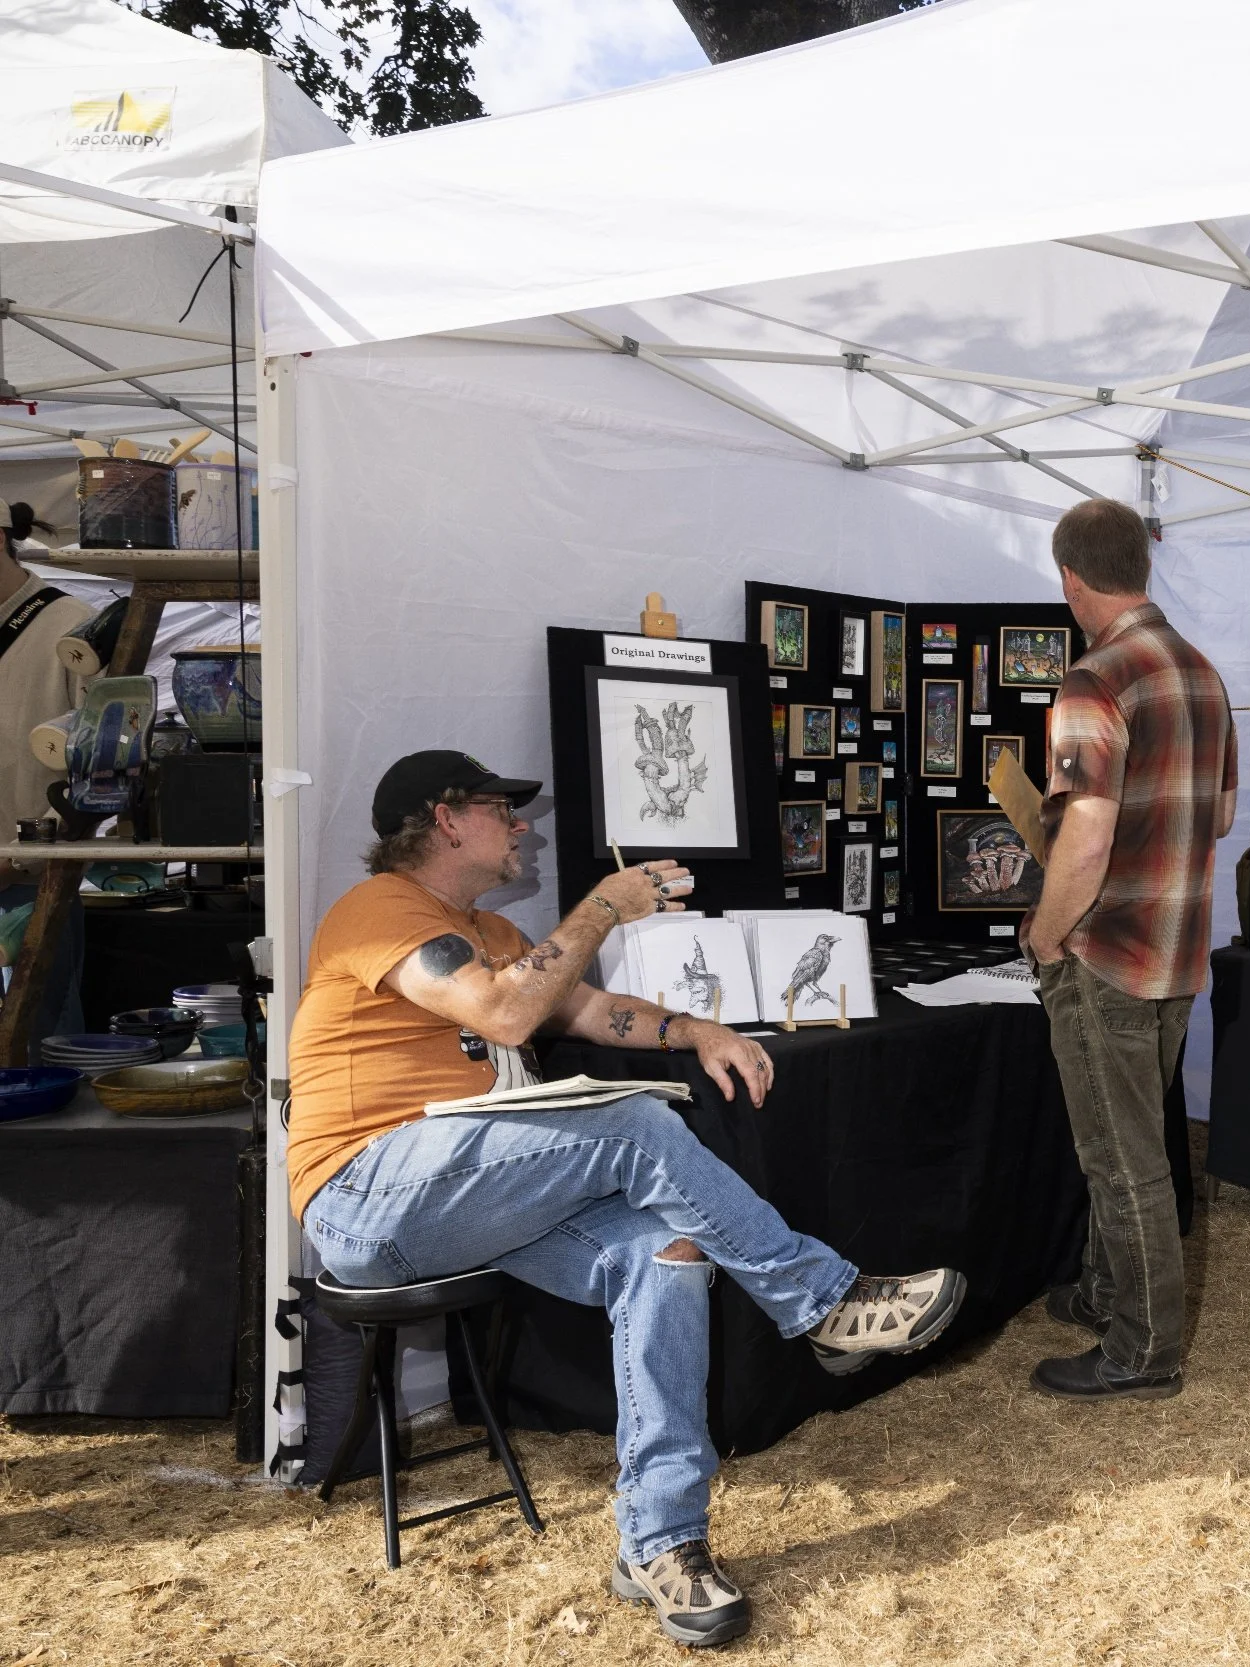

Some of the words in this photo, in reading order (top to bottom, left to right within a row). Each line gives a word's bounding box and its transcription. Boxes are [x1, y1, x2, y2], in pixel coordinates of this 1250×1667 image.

[71, 134, 164, 147] ABCCANOPY
[8, 598, 46, 630] Pleasing
[611, 646, 655, 658] Original
[658, 650, 706, 663] Drawings
